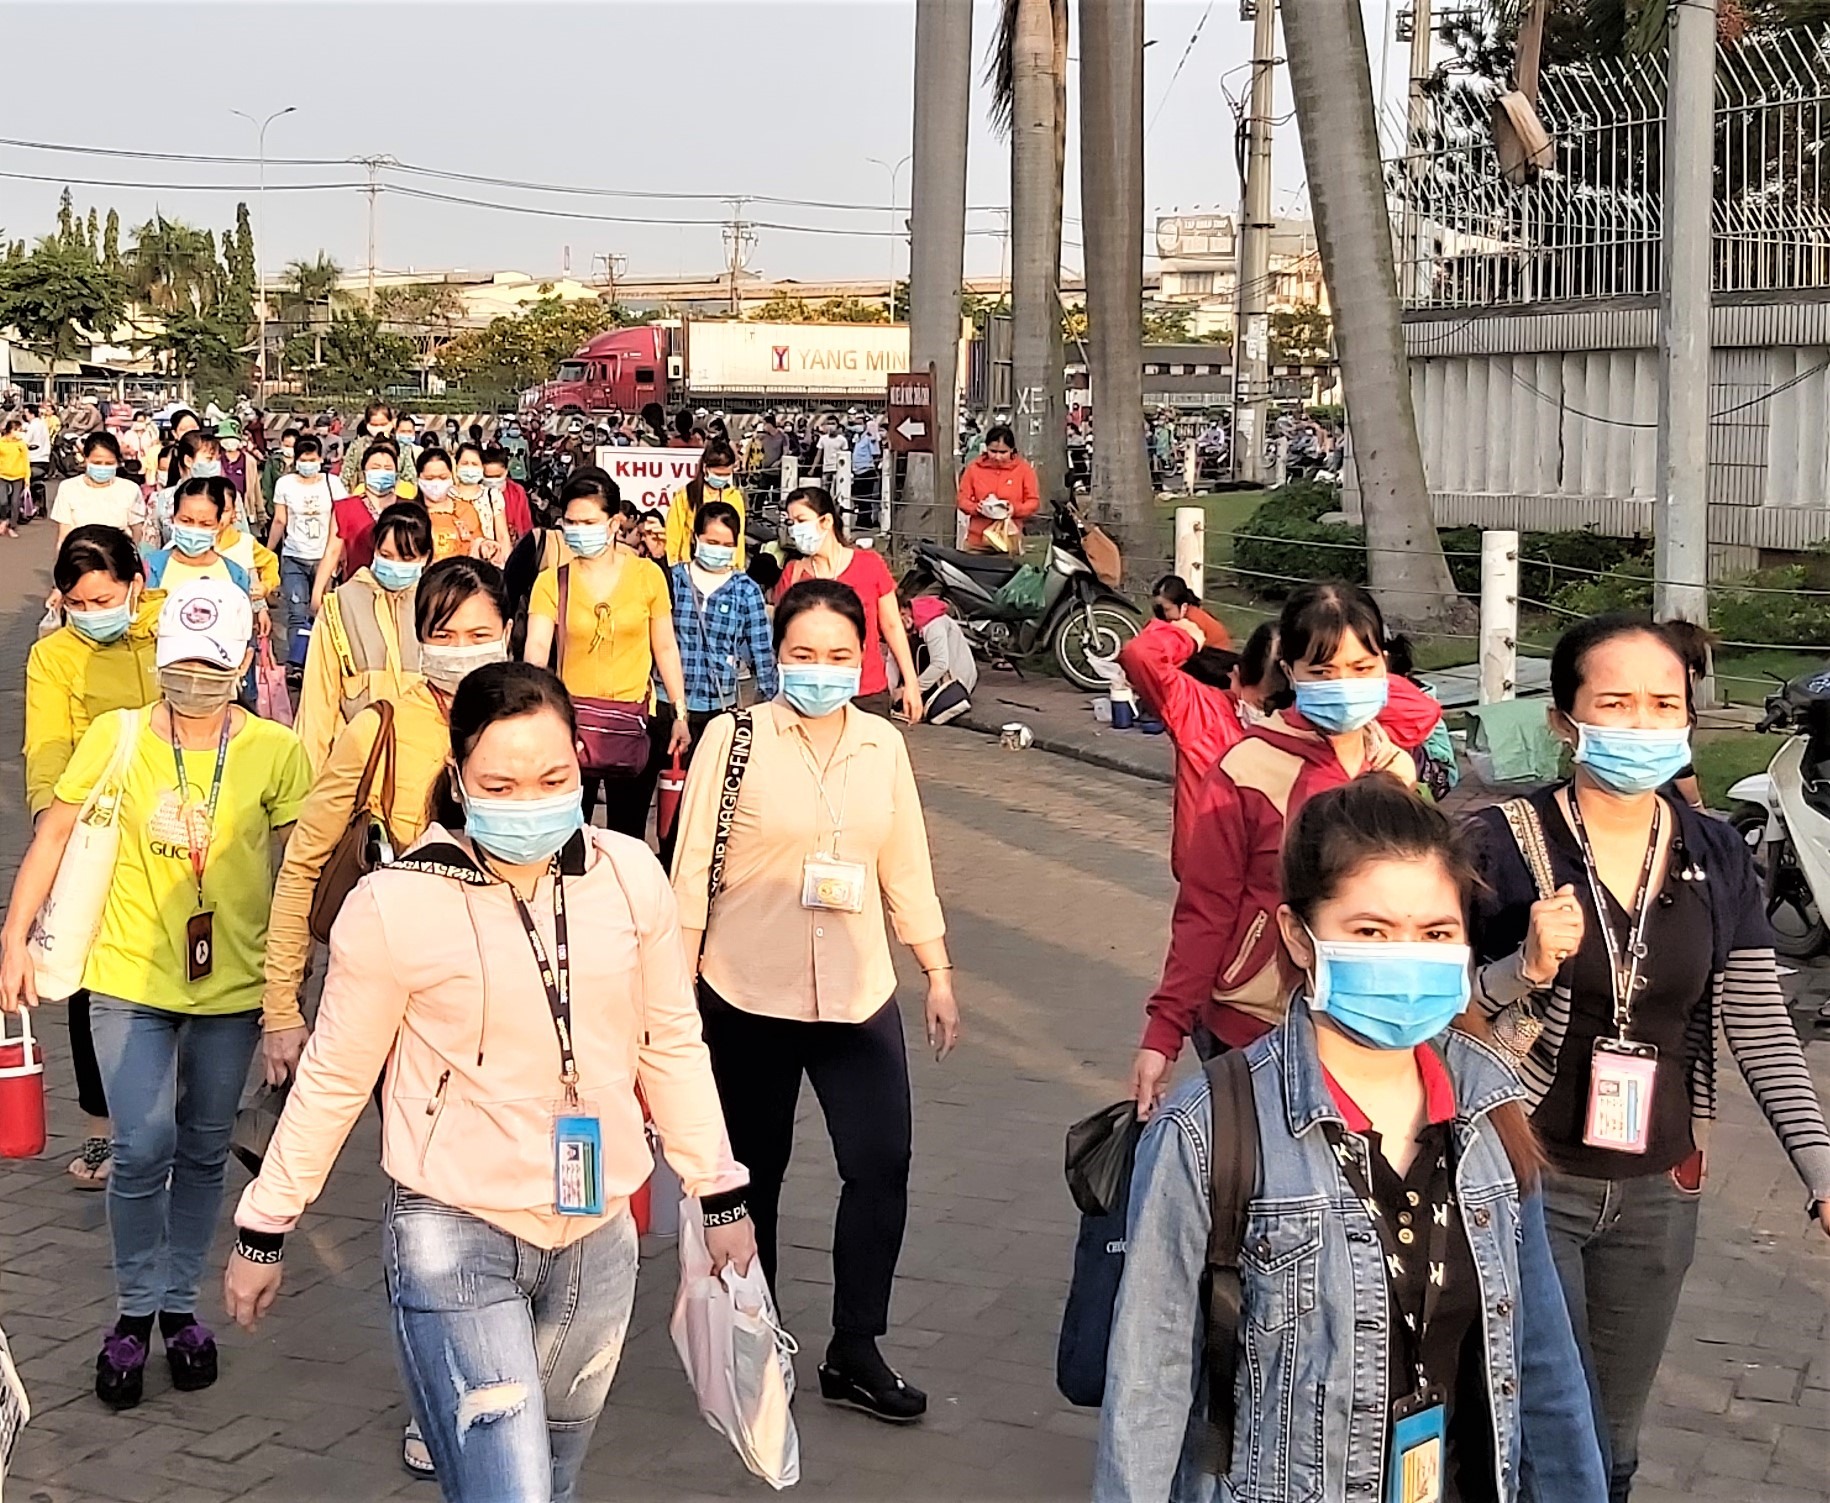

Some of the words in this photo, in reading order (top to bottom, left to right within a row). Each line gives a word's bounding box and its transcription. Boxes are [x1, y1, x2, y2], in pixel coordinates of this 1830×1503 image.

[800, 349, 857, 370] YANG
[866, 350, 907, 371] MIN
[1016, 387, 1044, 414] XE
[615, 460, 663, 479] KHU
[670, 462, 699, 479] VU
[641, 484, 677, 508] CẤ
[717, 775, 741, 838] MAGIC
[729, 726, 752, 768] FIND
[149, 840, 191, 861] GUC
